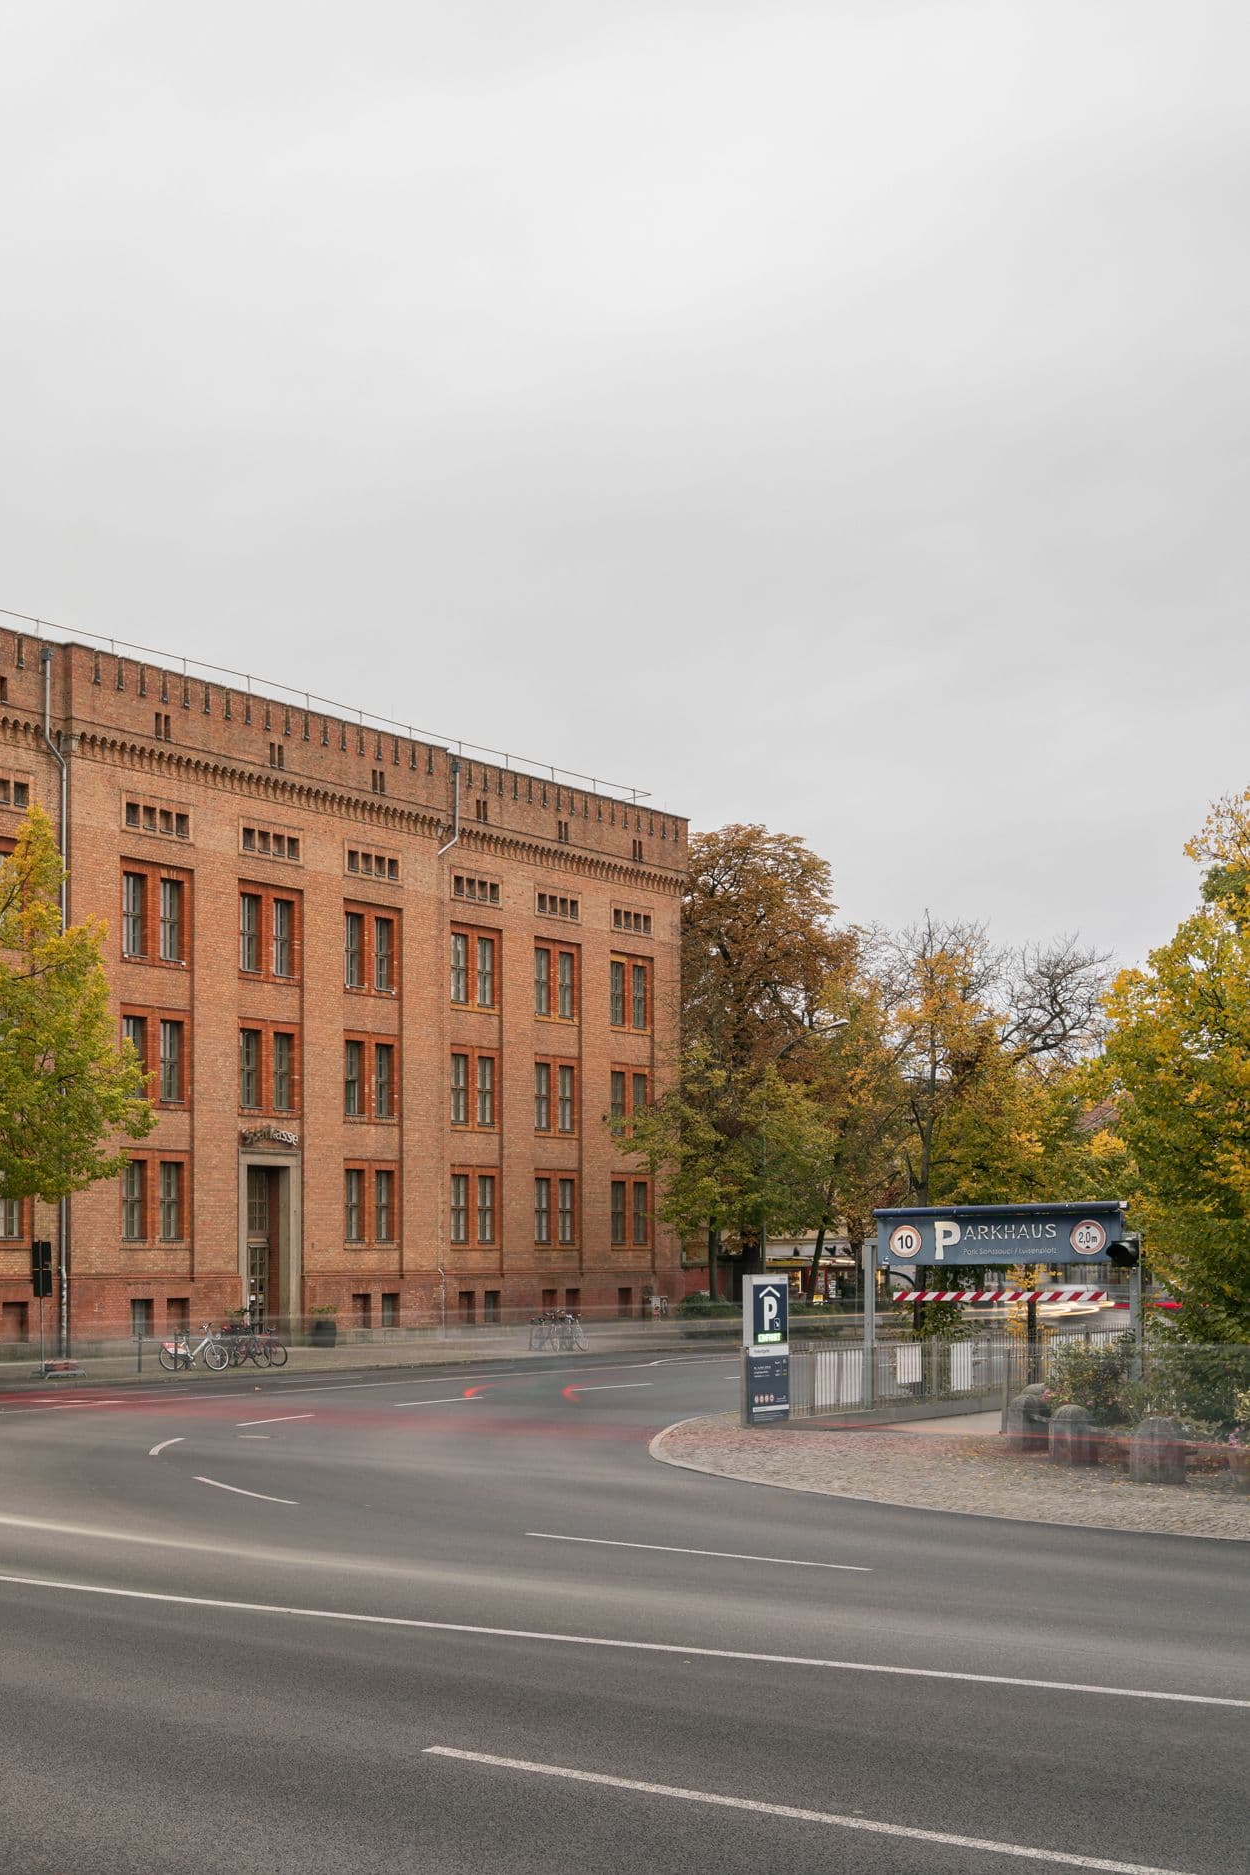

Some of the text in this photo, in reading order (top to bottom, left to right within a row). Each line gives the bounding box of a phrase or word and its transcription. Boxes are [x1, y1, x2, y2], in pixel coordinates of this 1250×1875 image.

[897, 1234, 913, 1249] 10
[934, 1221, 1057, 1260] PARKHAUS
[763, 1296, 778, 1331] P
